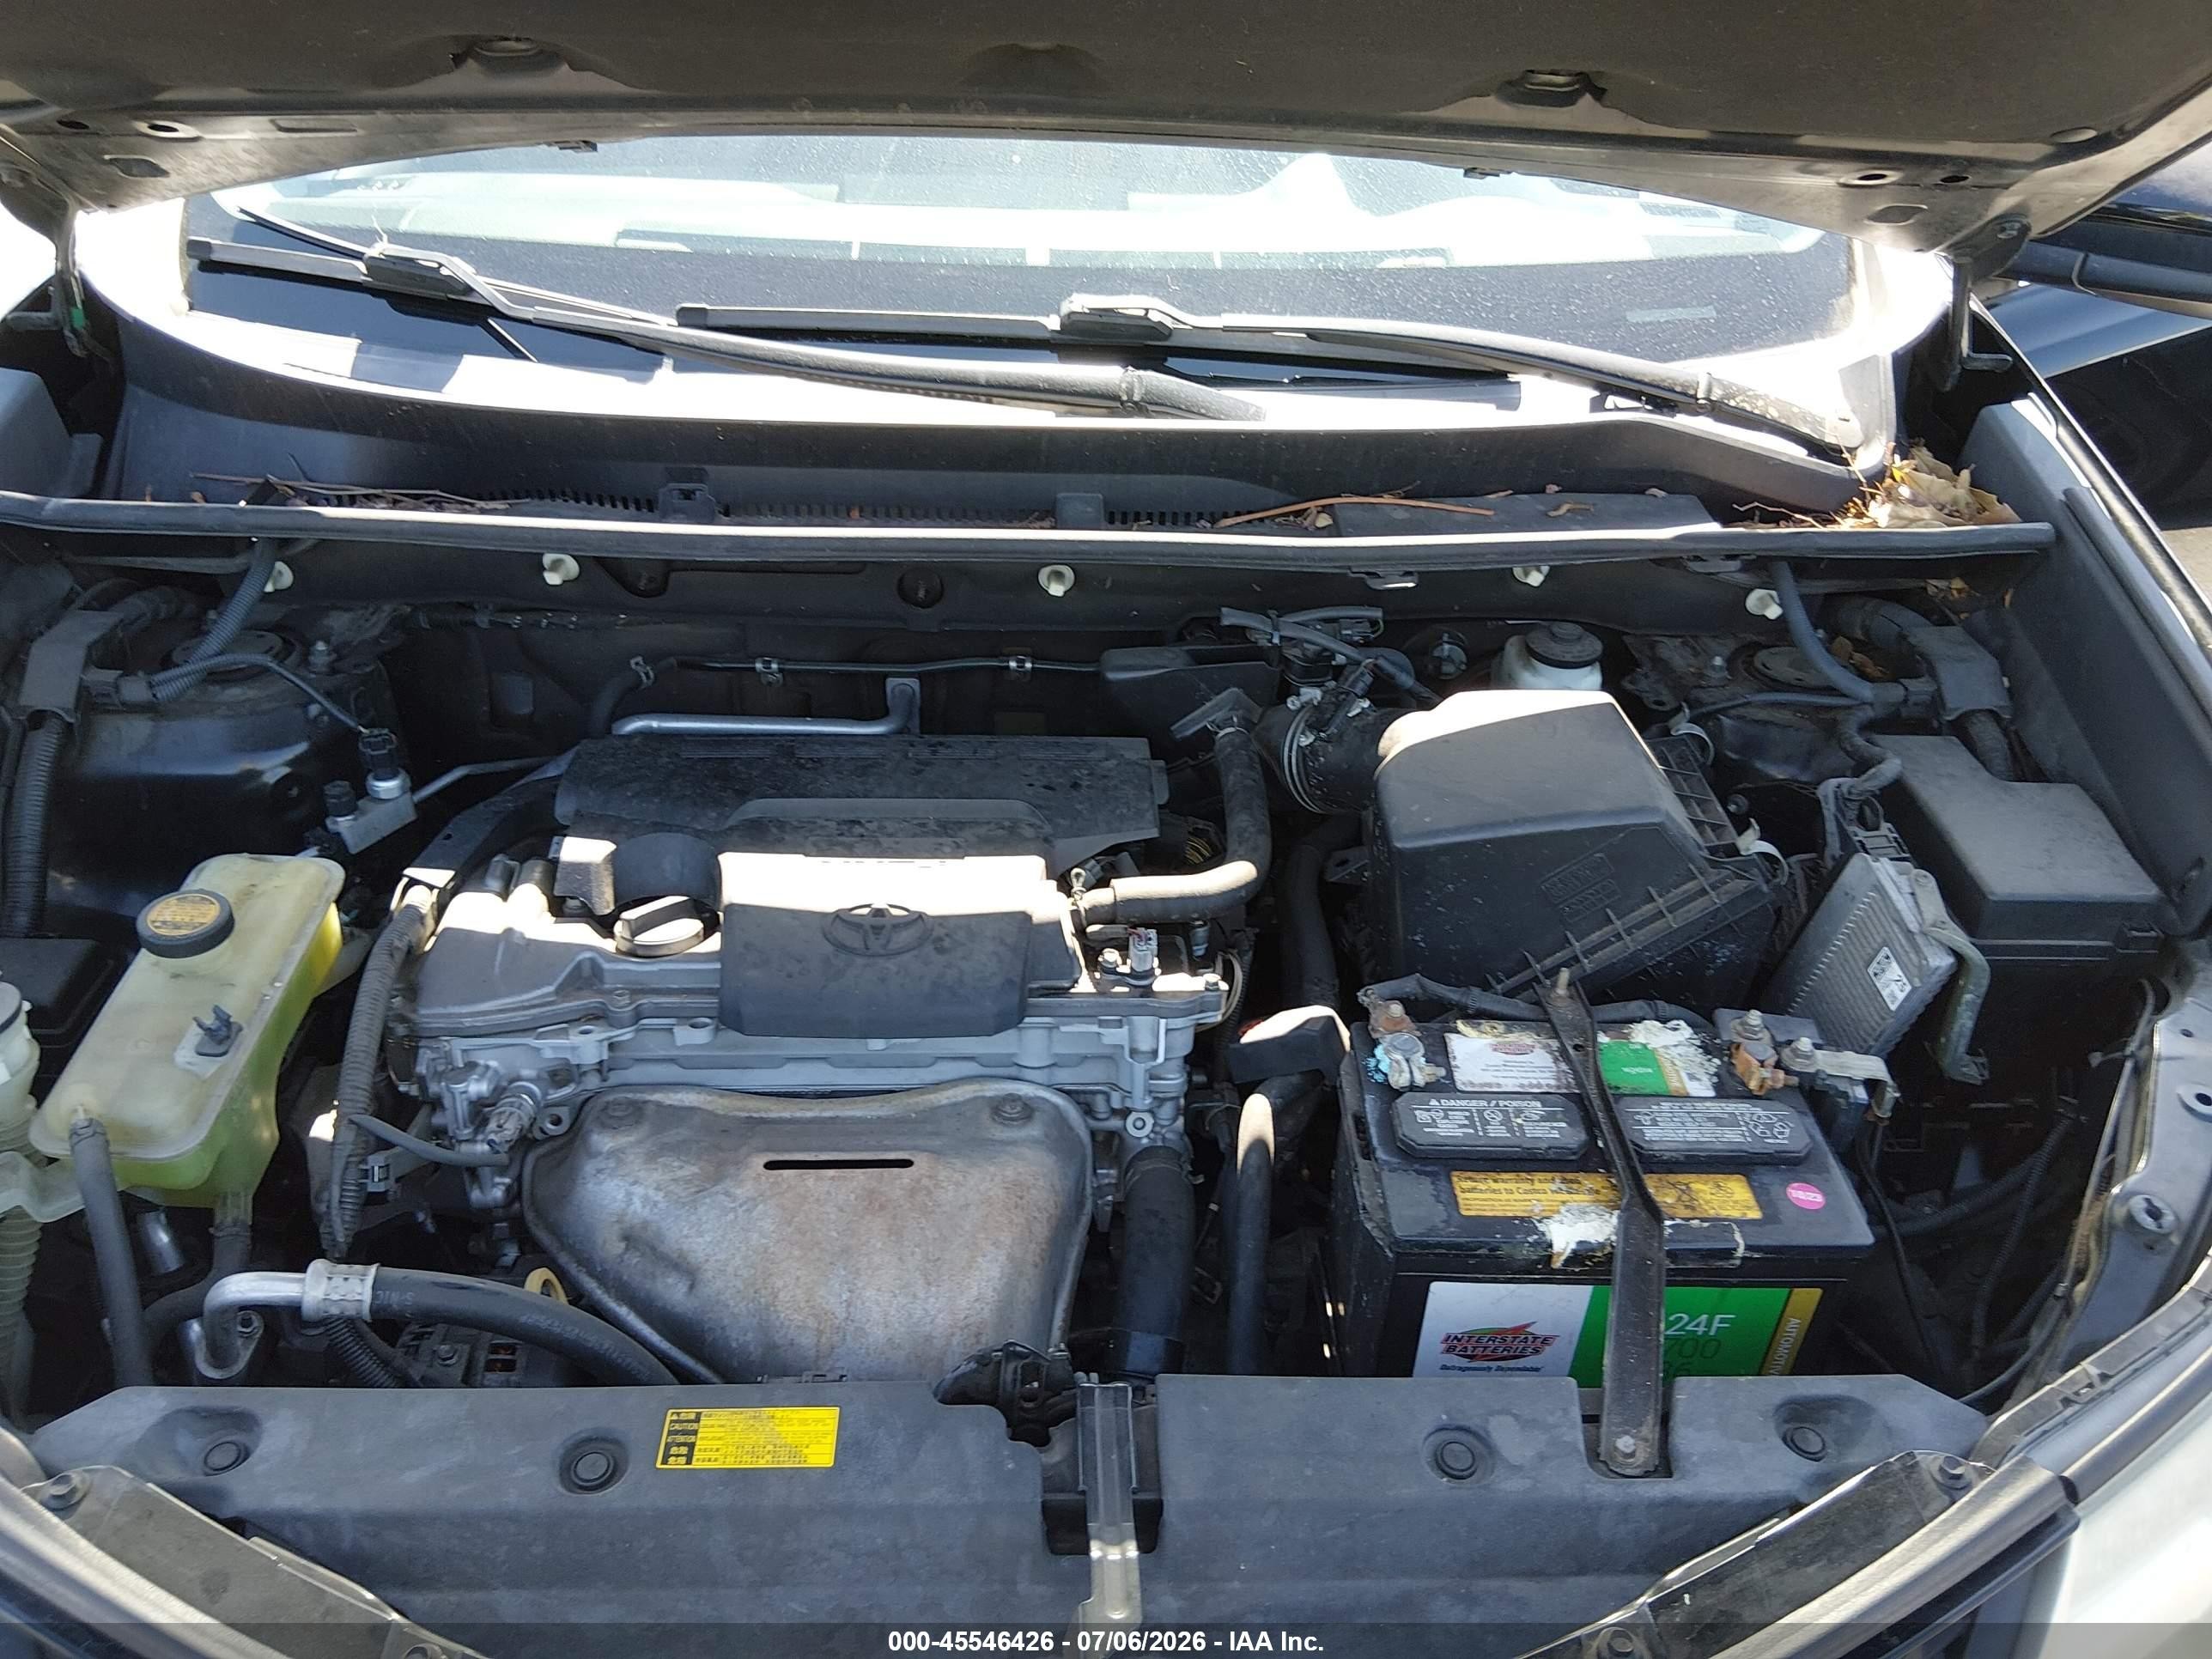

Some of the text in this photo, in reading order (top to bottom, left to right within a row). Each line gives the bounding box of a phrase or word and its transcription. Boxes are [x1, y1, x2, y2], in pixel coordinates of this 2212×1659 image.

[1664, 1312, 1738, 1336] 24F
[1444, 1334, 1554, 1346] INTERSTATE
[1769, 1317, 1802, 1376] AUTOMOTIV
[1445, 1345, 1543, 1355] BATTERIES
